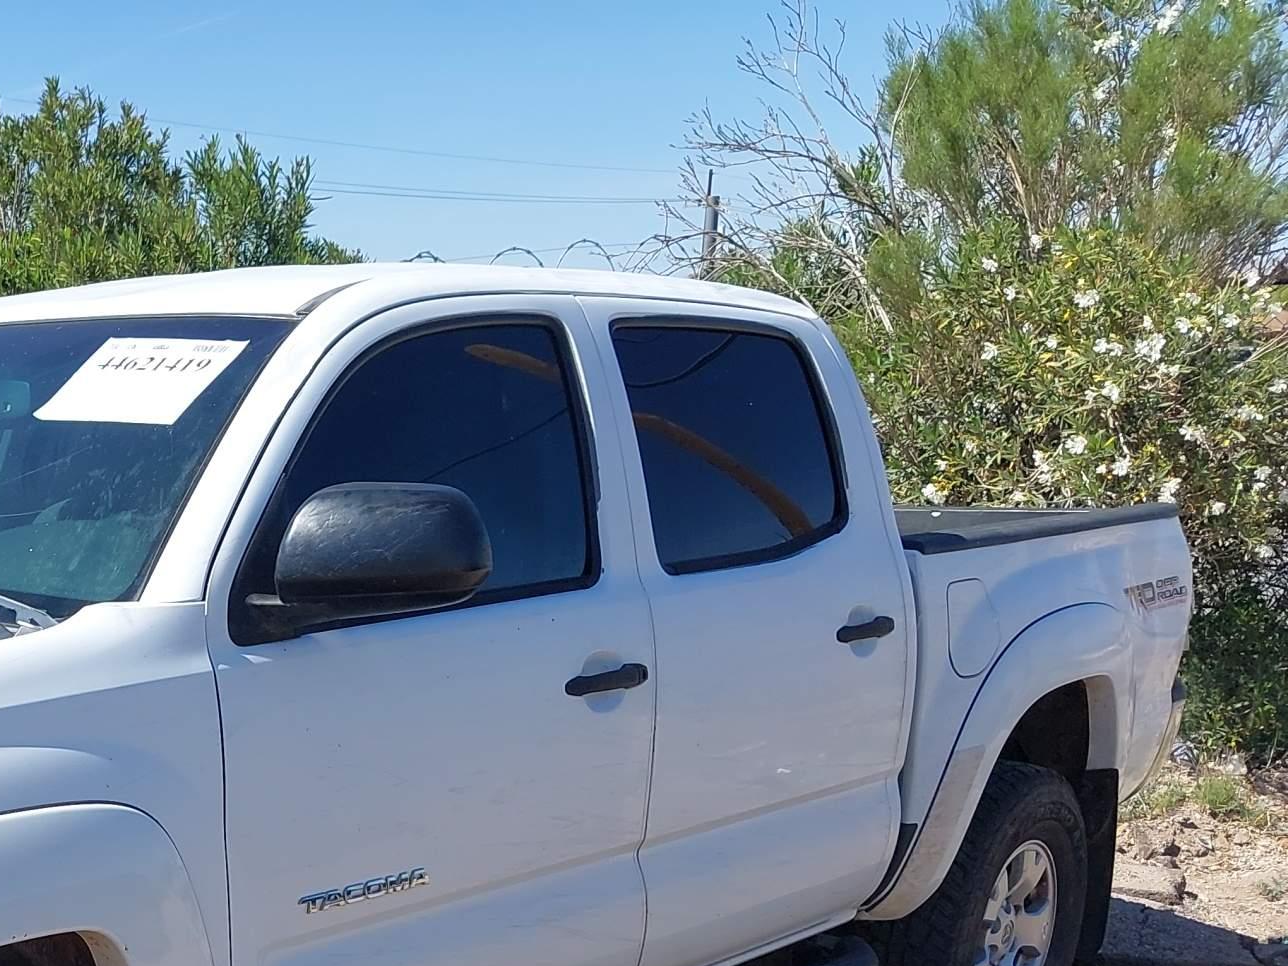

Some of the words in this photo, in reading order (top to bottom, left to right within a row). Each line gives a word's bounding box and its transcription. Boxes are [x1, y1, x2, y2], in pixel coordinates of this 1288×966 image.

[98, 356, 212, 373] 44621419
[1157, 585, 1188, 601] ROAD
[298, 867, 430, 914] TACOMA
